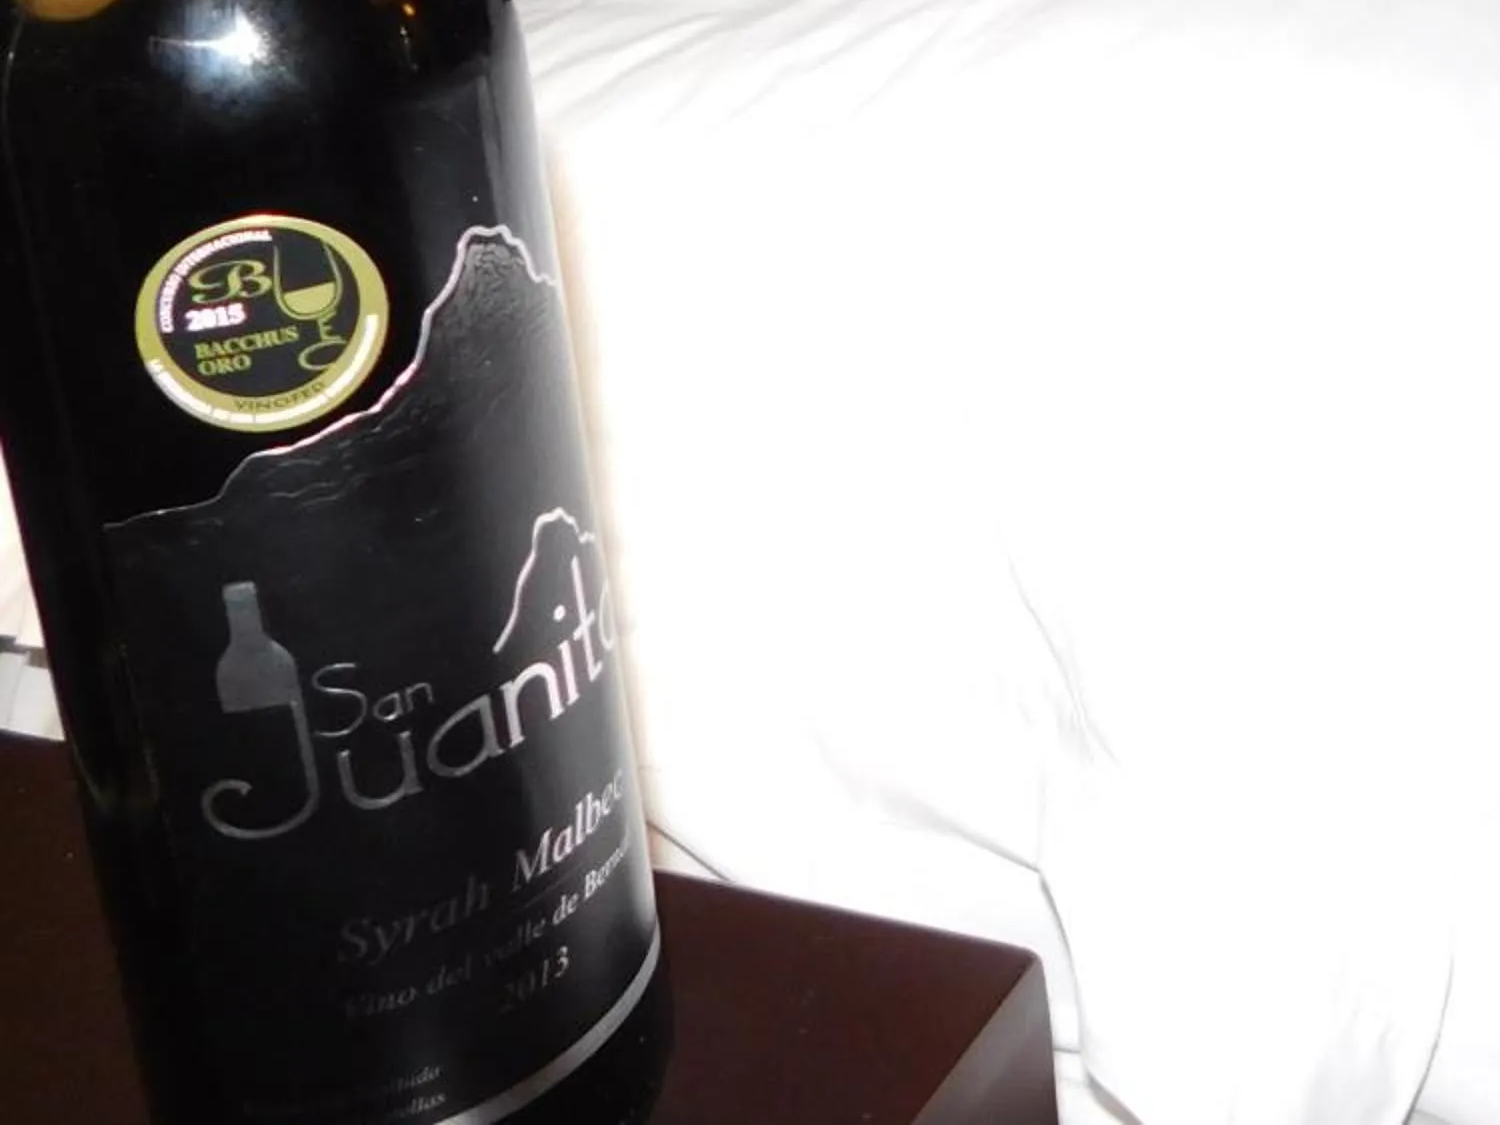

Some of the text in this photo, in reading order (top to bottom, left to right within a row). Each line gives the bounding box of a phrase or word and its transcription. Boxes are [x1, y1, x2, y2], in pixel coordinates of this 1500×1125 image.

[184, 302, 247, 332] 2015
[194, 325, 299, 360] BACCHUS
[197, 353, 252, 376] ORO
[311, 662, 435, 738] San
[337, 768, 624, 967] Syrah Malbec
[426, 952, 472, 997] del
[552, 890, 580, 926] de
[500, 944, 571, 1015] 2013
